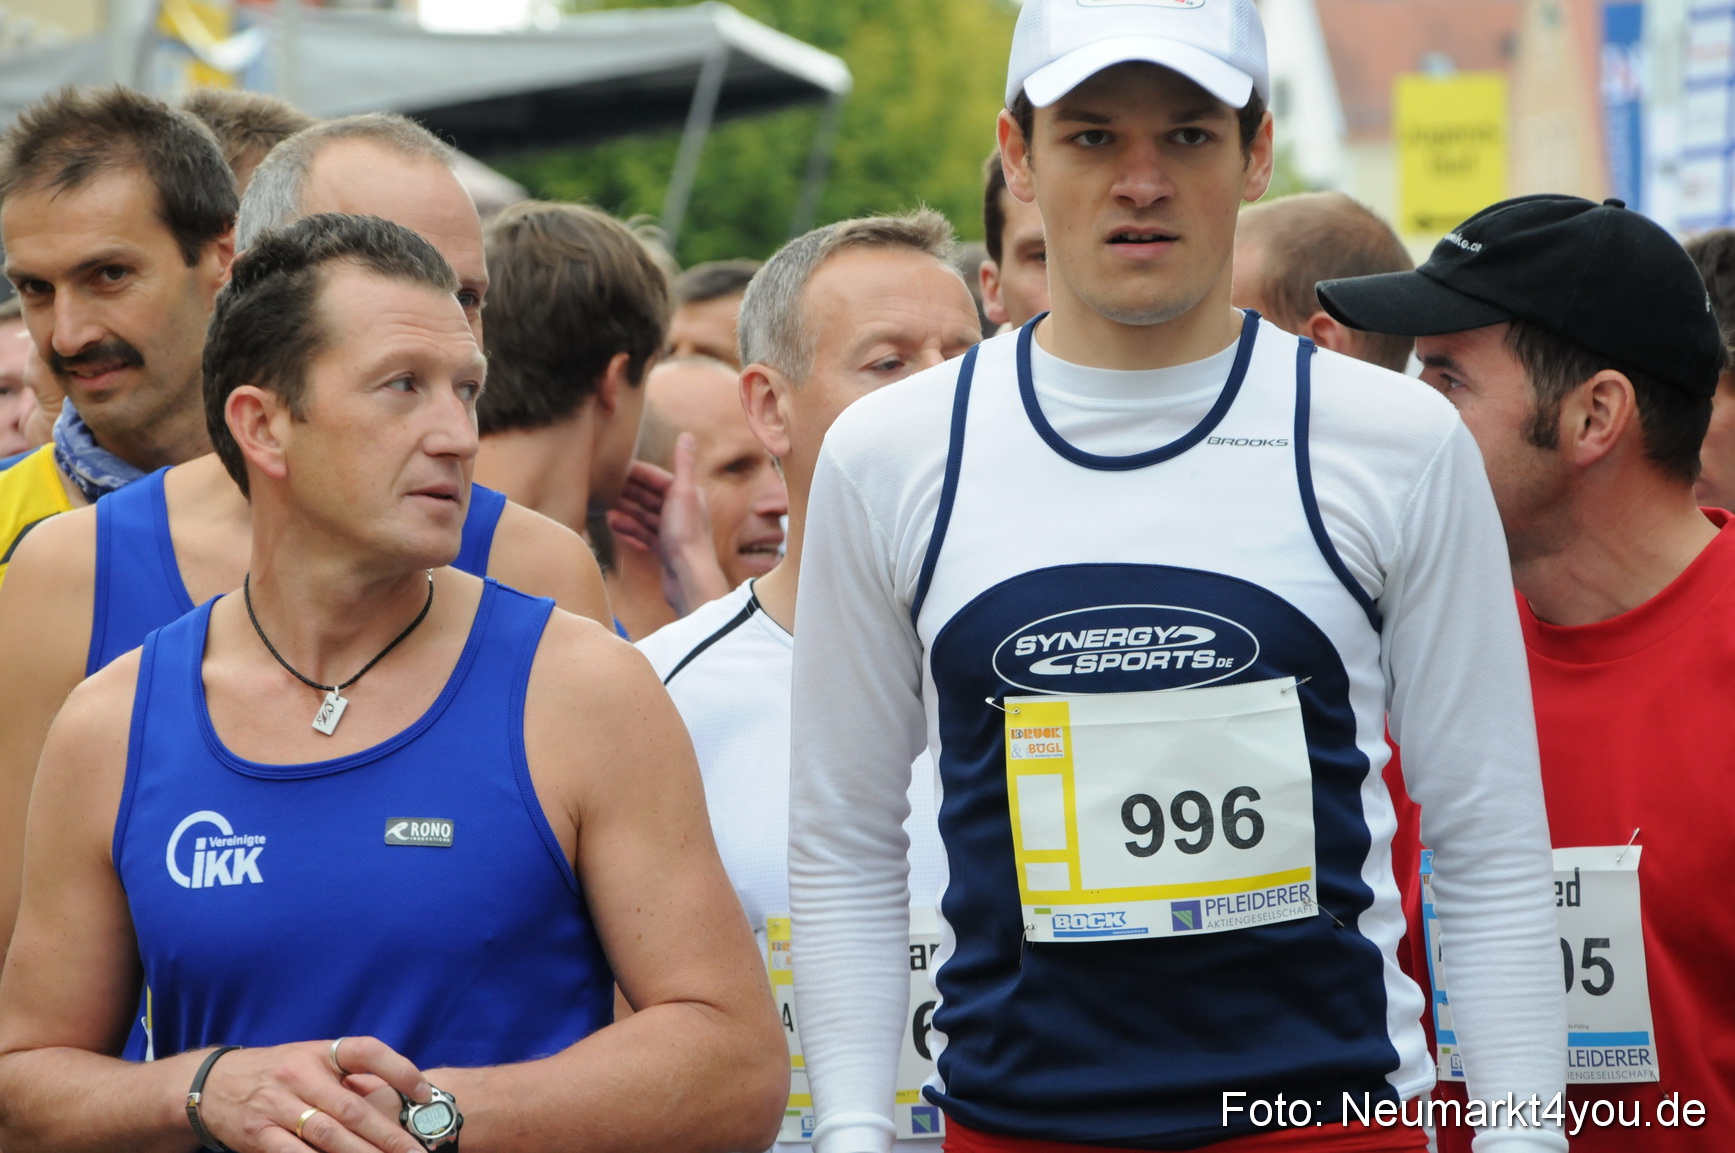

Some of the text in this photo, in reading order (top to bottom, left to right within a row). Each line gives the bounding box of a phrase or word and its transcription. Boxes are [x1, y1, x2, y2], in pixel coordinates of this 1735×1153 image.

[1206, 436, 1289, 447] BROOKS
[1015, 626, 1182, 657] SYNERGY
[1073, 649, 1216, 675] SPORTS
[1028, 742, 1063, 754] BÖGL
[410, 821, 452, 838] RONO
[1120, 786, 1265, 858] 996
[209, 834, 266, 849] Vereinigte
[1554, 866, 1581, 908] ed
[1205, 883, 1311, 917] PFLEIDERER
[1052, 911, 1127, 930] BOCK
[1206, 903, 1314, 930] AKTIENGESELLSCHAFT
[912, 1000, 938, 1061] 6
[1567, 1048, 1652, 1068] LEIDERER
[1567, 1064, 1654, 1080] IENGESELLSCHAFT
